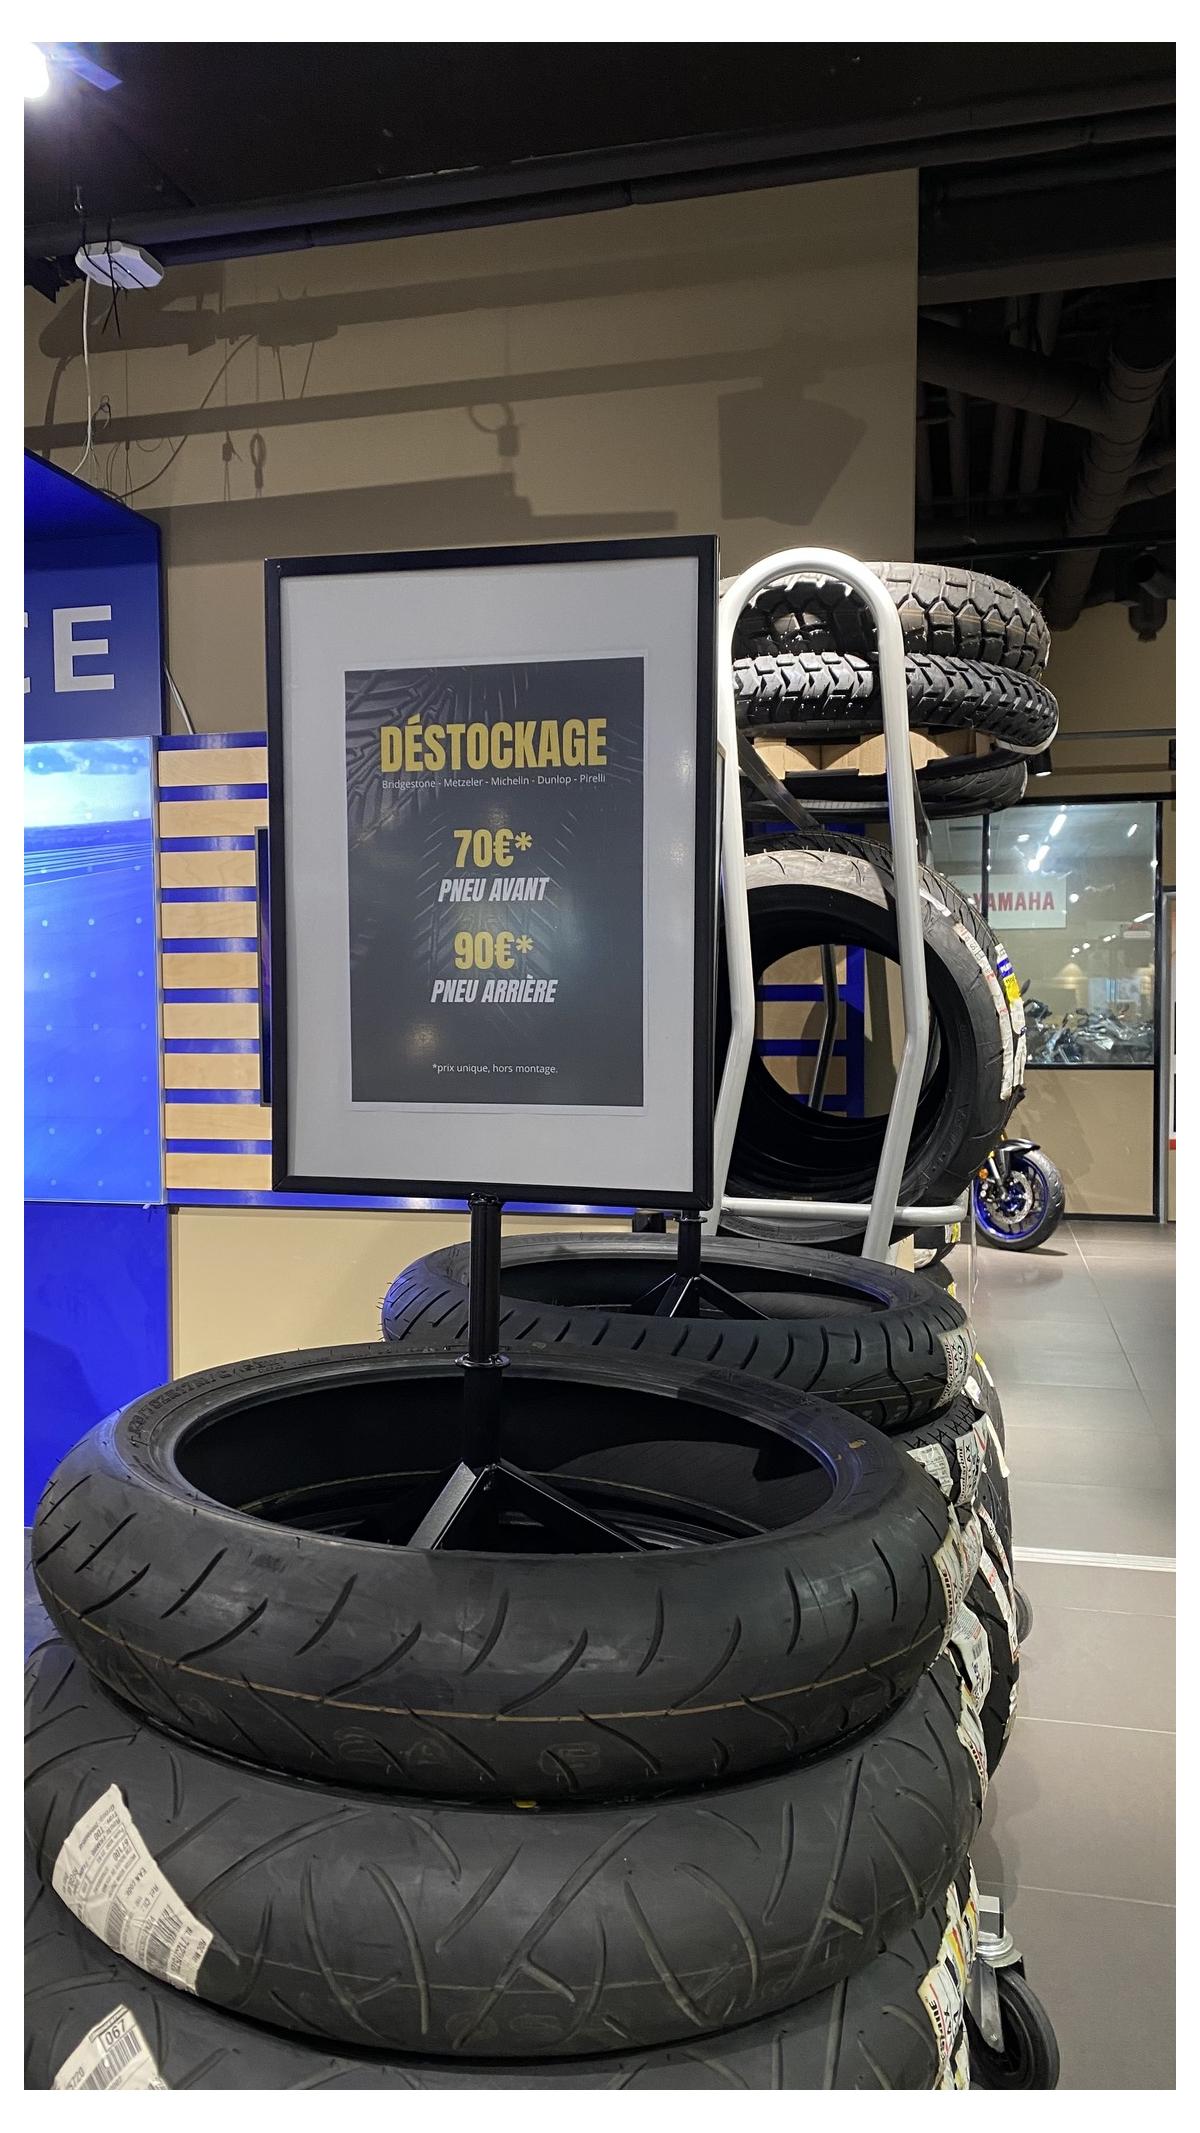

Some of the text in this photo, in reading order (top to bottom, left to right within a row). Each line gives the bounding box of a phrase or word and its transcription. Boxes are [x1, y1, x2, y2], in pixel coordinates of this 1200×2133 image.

[24, 605, 115, 694] E
[380, 714, 608, 773] DÉSTOCKAGE
[382, 779, 437, 791] Bridgestone
[443, 778, 484, 788] Metzeler
[491, 776, 530, 786] Michelin
[538, 775, 571, 787] Dunlop
[580, 773, 606, 784] Pirelli
[437, 876, 551, 903] PNEU AVANT
[973, 891, 1055, 911] YAMAHA
[430, 974, 559, 1003] PNEU ARRIÈRE
[456, 1063, 490, 1075] unique,
[492, 1063, 513, 1073] hors
[515, 1064, 559, 1076] montage.
[105, 2018, 126, 2046] 067
